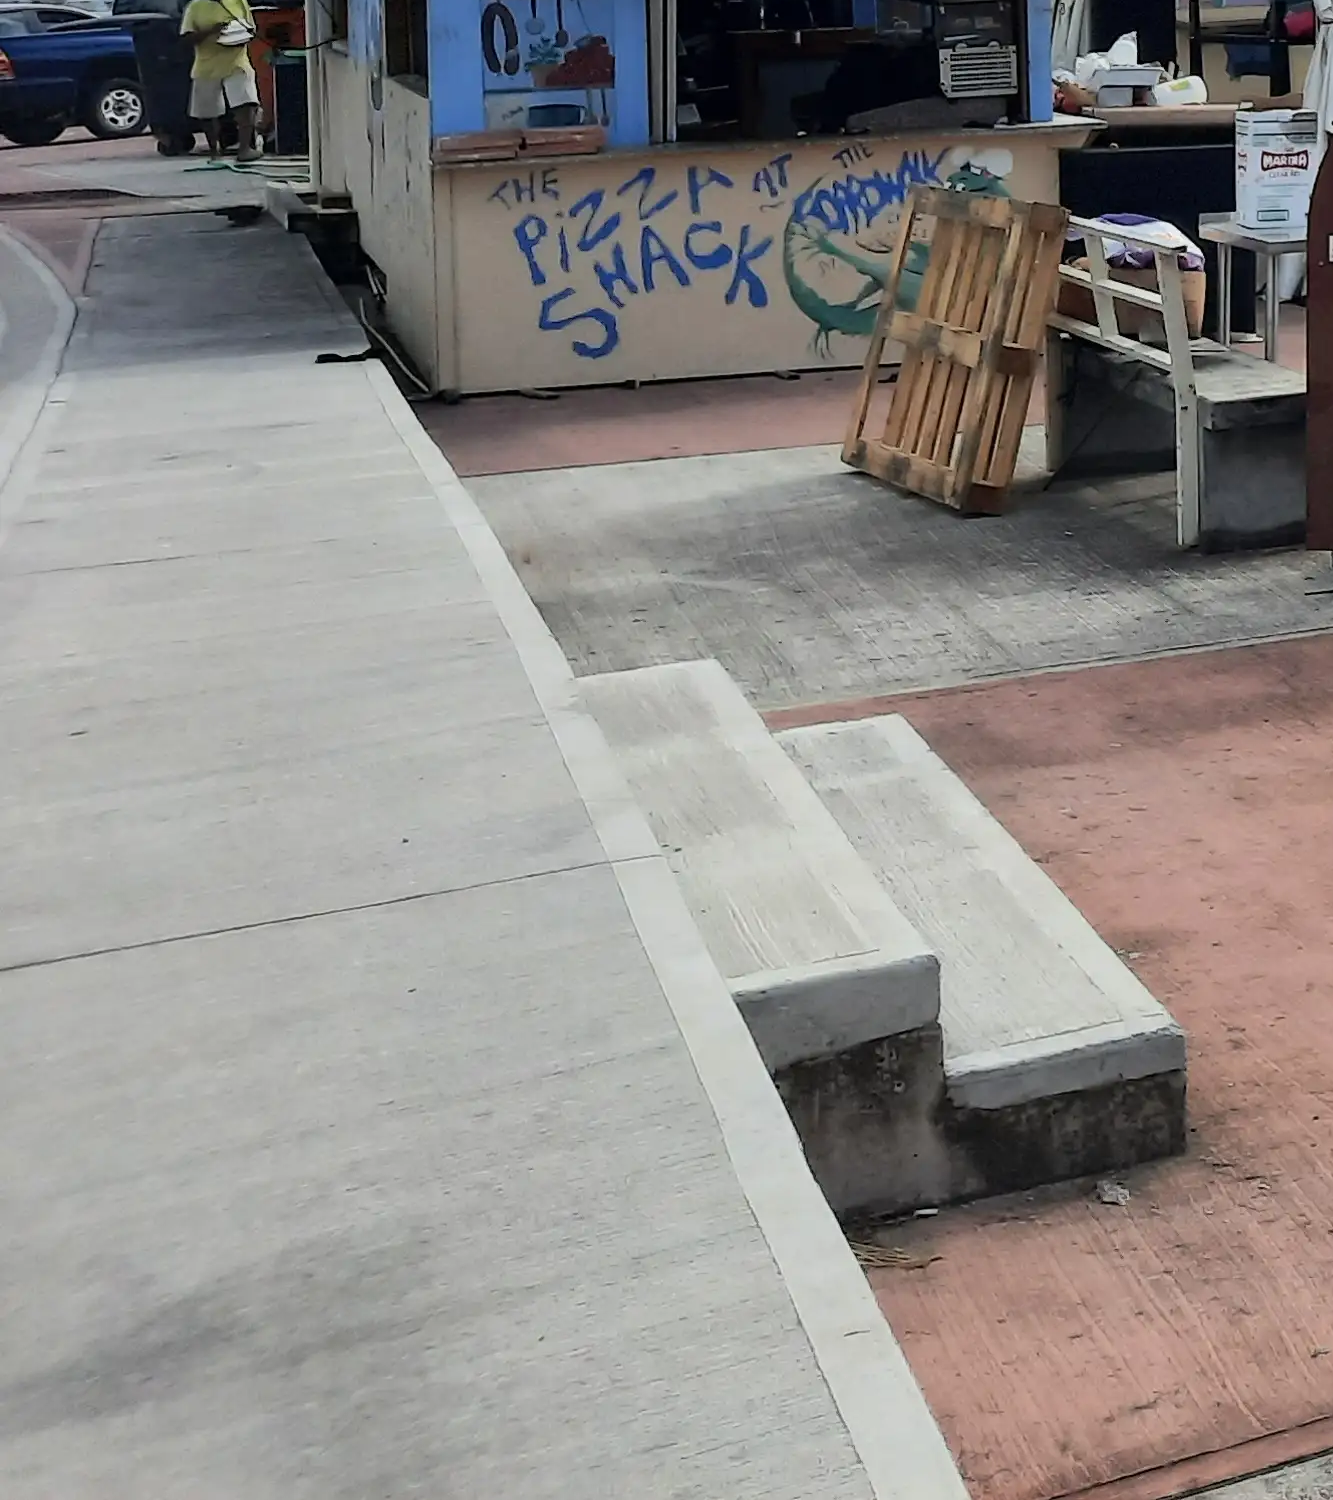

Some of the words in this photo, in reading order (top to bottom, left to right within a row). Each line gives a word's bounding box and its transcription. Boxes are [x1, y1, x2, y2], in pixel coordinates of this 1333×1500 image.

[753, 153, 792, 197] AT
[832, 142, 874, 169] THE
[488, 168, 560, 210] THE
[538, 221, 773, 359] SHACK
